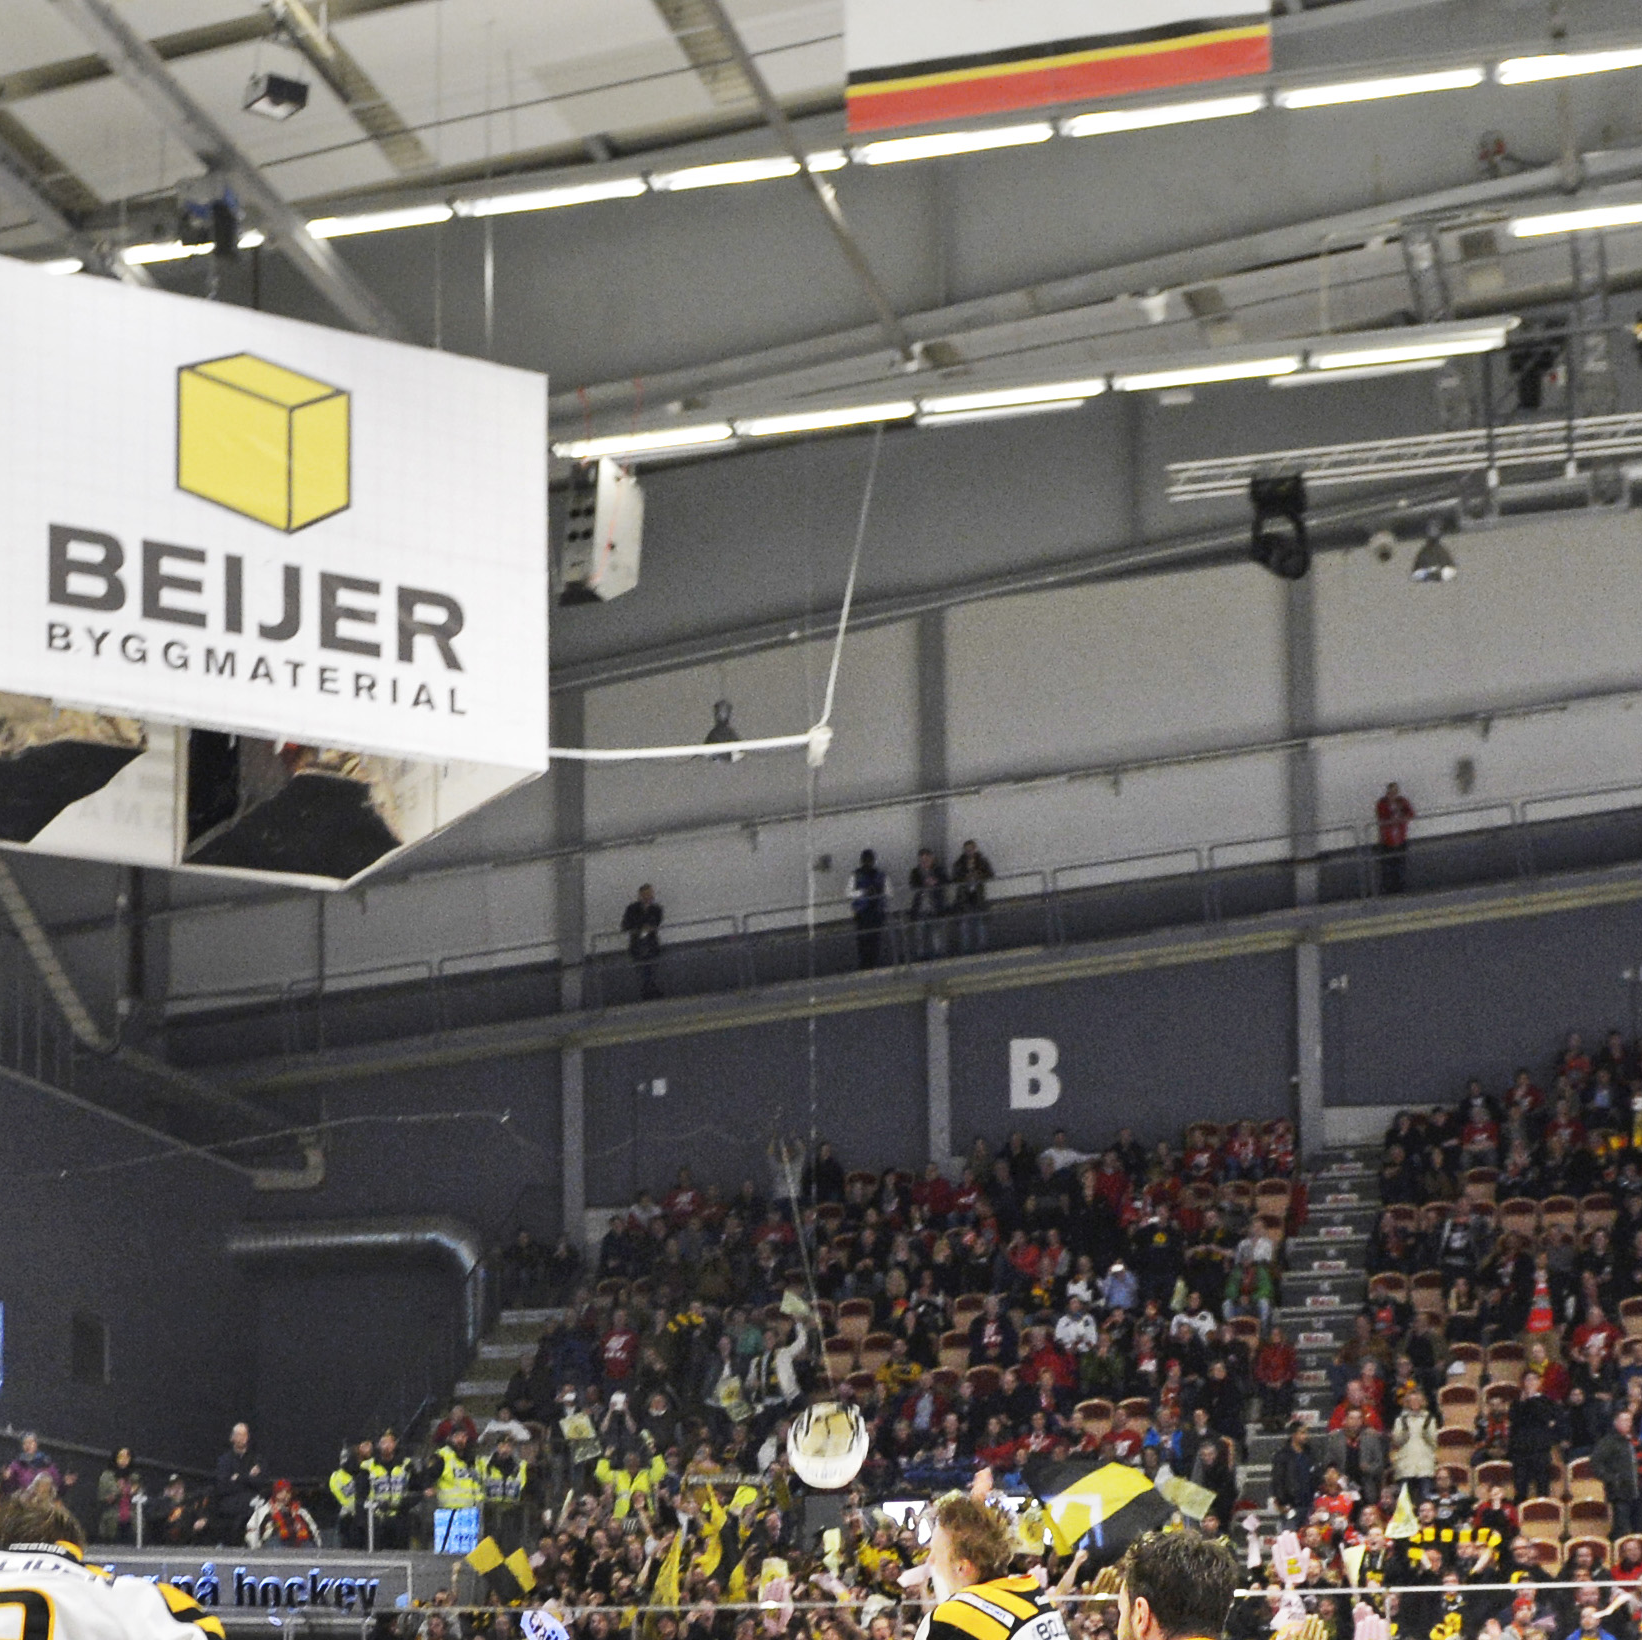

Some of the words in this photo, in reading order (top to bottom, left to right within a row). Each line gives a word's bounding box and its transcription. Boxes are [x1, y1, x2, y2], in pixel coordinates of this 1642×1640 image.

[49, 523, 468, 671] BEIJER
[47, 623, 468, 716] BYGGMATERIAL
[1009, 1037, 1061, 1109] B
[233, 1565, 380, 1614] hockey
